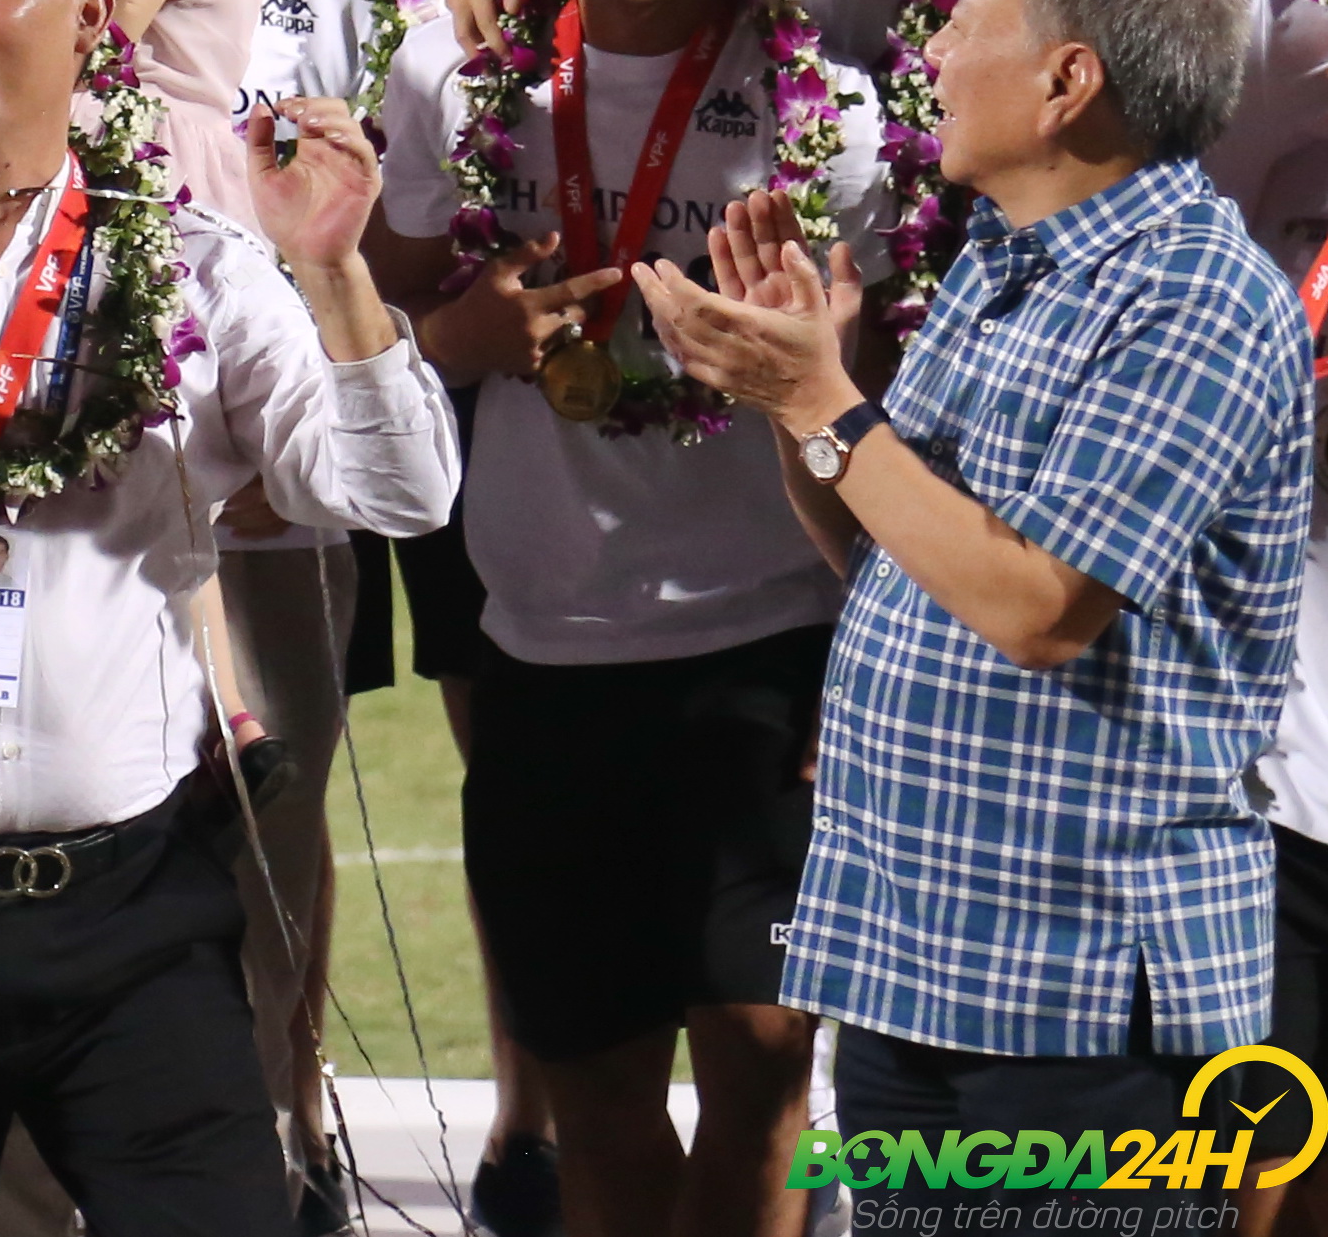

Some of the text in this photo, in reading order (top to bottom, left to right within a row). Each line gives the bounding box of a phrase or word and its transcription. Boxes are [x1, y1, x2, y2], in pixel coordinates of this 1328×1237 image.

[260, 10, 315, 34] Kappa
[558, 57, 575, 96] VPF
[697, 115, 757, 139] Kappa
[647, 130, 670, 168] VPF
[565, 174, 583, 214] VPF
[35, 254, 60, 292] VPF
